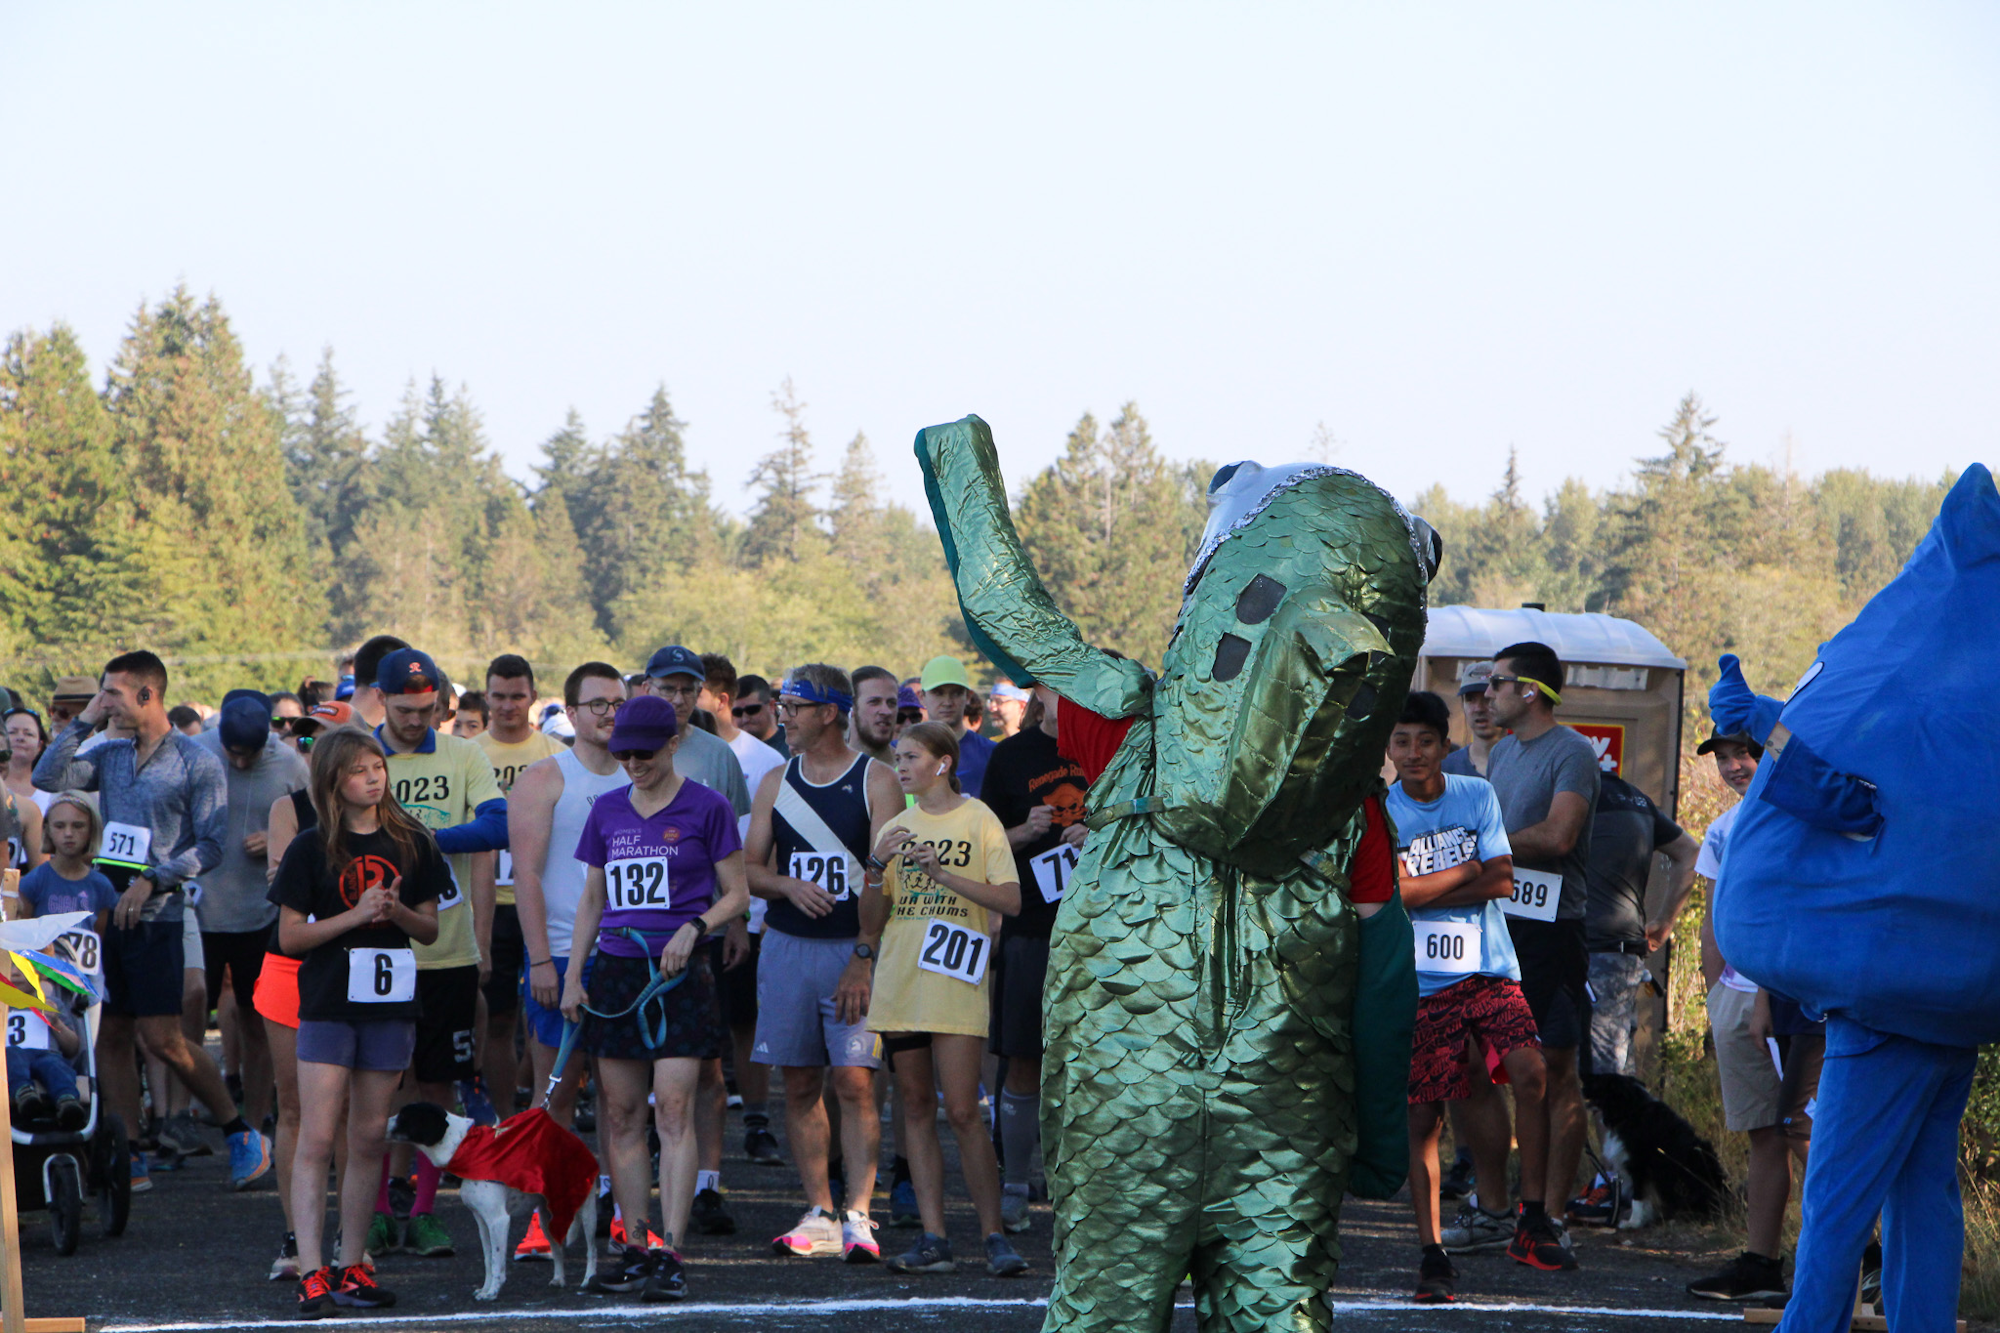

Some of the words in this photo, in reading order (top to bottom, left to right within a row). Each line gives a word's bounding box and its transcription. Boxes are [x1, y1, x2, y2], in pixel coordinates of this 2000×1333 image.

[1028, 765, 1068, 793] Renegade
[108, 832, 135, 856] 571
[611, 845, 679, 858] MARATHON
[612, 835, 641, 847] HALF
[1409, 827, 1469, 857] ALLIANCE
[1406, 841, 1475, 877] REBELS
[610, 862, 666, 907] 132
[792, 856, 845, 894] 126
[920, 906, 968, 917] CHUMS
[923, 895, 957, 905] WITH
[922, 924, 984, 976] 201
[1427, 933, 1464, 960] 600
[374, 953, 393, 995] 6
[8, 1015, 26, 1046] 3
